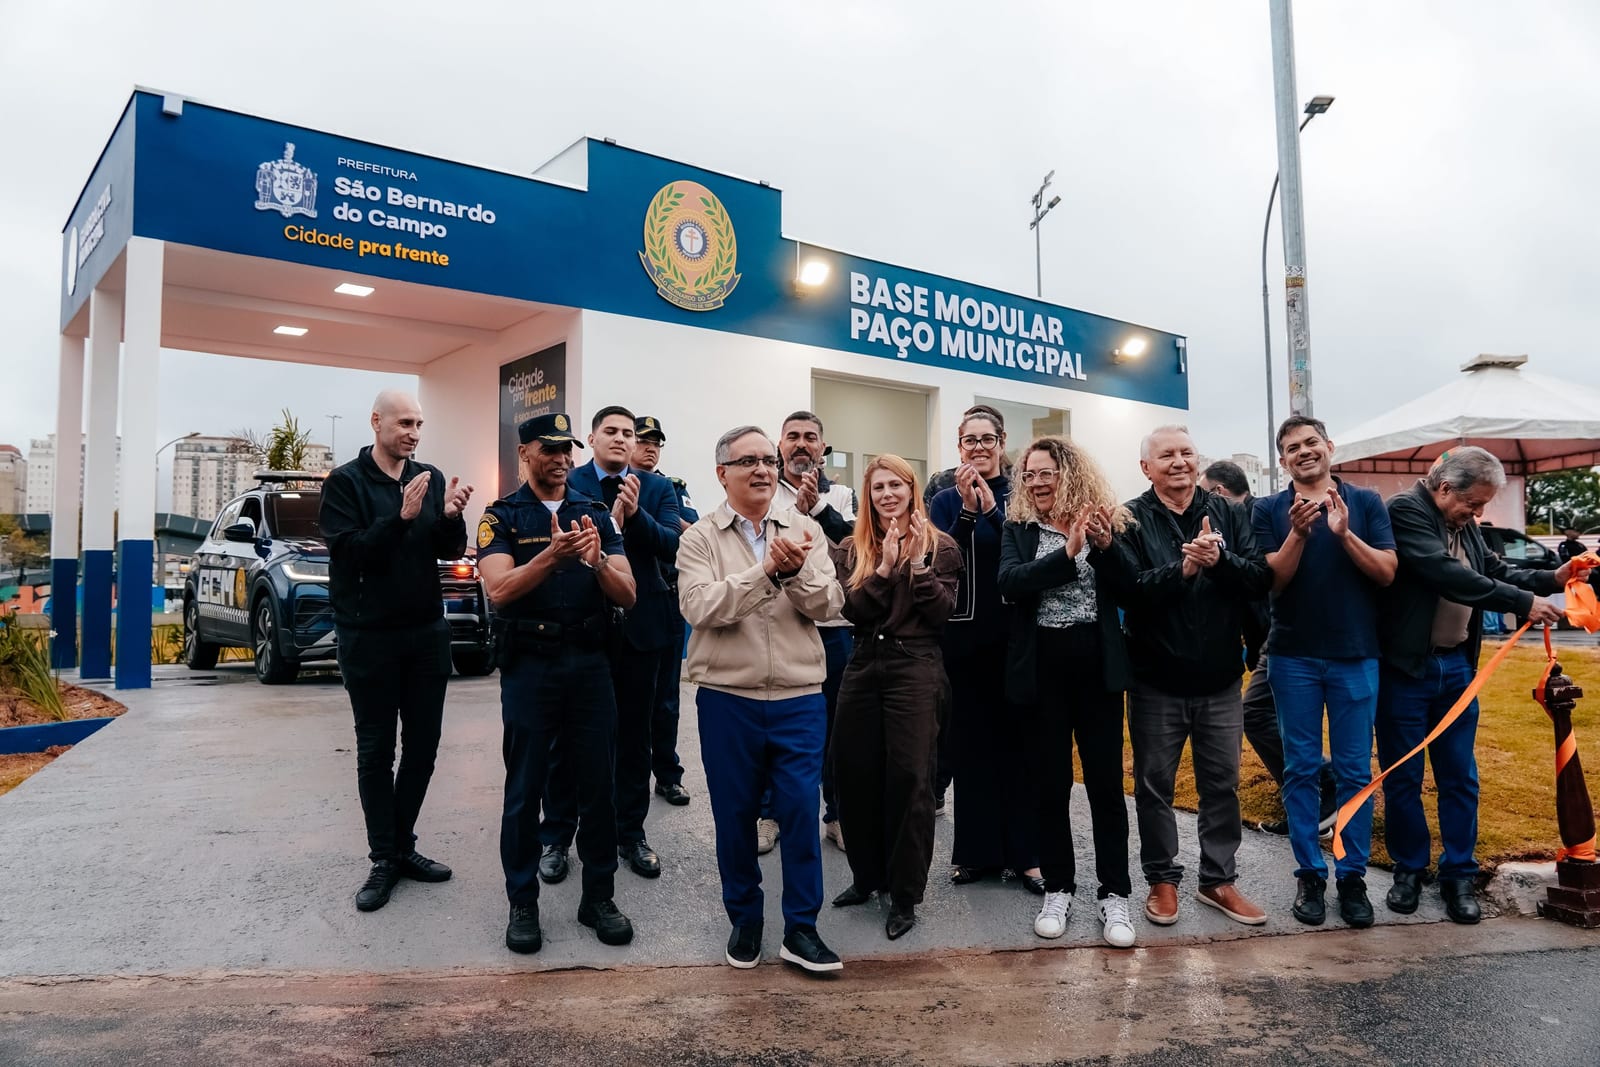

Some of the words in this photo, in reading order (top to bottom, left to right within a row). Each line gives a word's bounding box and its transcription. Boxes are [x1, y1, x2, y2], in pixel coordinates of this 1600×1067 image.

[337, 156, 418, 182] PREFEITURA
[332, 201, 363, 223] do
[367, 209, 448, 239] Campo
[334, 176, 381, 202] São
[387, 186, 497, 224] Bernardo
[283, 224, 354, 250] Cidade
[359, 239, 392, 258] pra
[394, 243, 450, 267] frente
[850, 271, 929, 318] BASE
[934, 290, 1065, 346] MODULAR
[850, 308, 935, 359] PAÇO
[940, 326, 1088, 381] MUNICIPAL
[508, 367, 544, 394] Cidade
[512, 389, 525, 407] pra
[525, 383, 557, 407] frente
